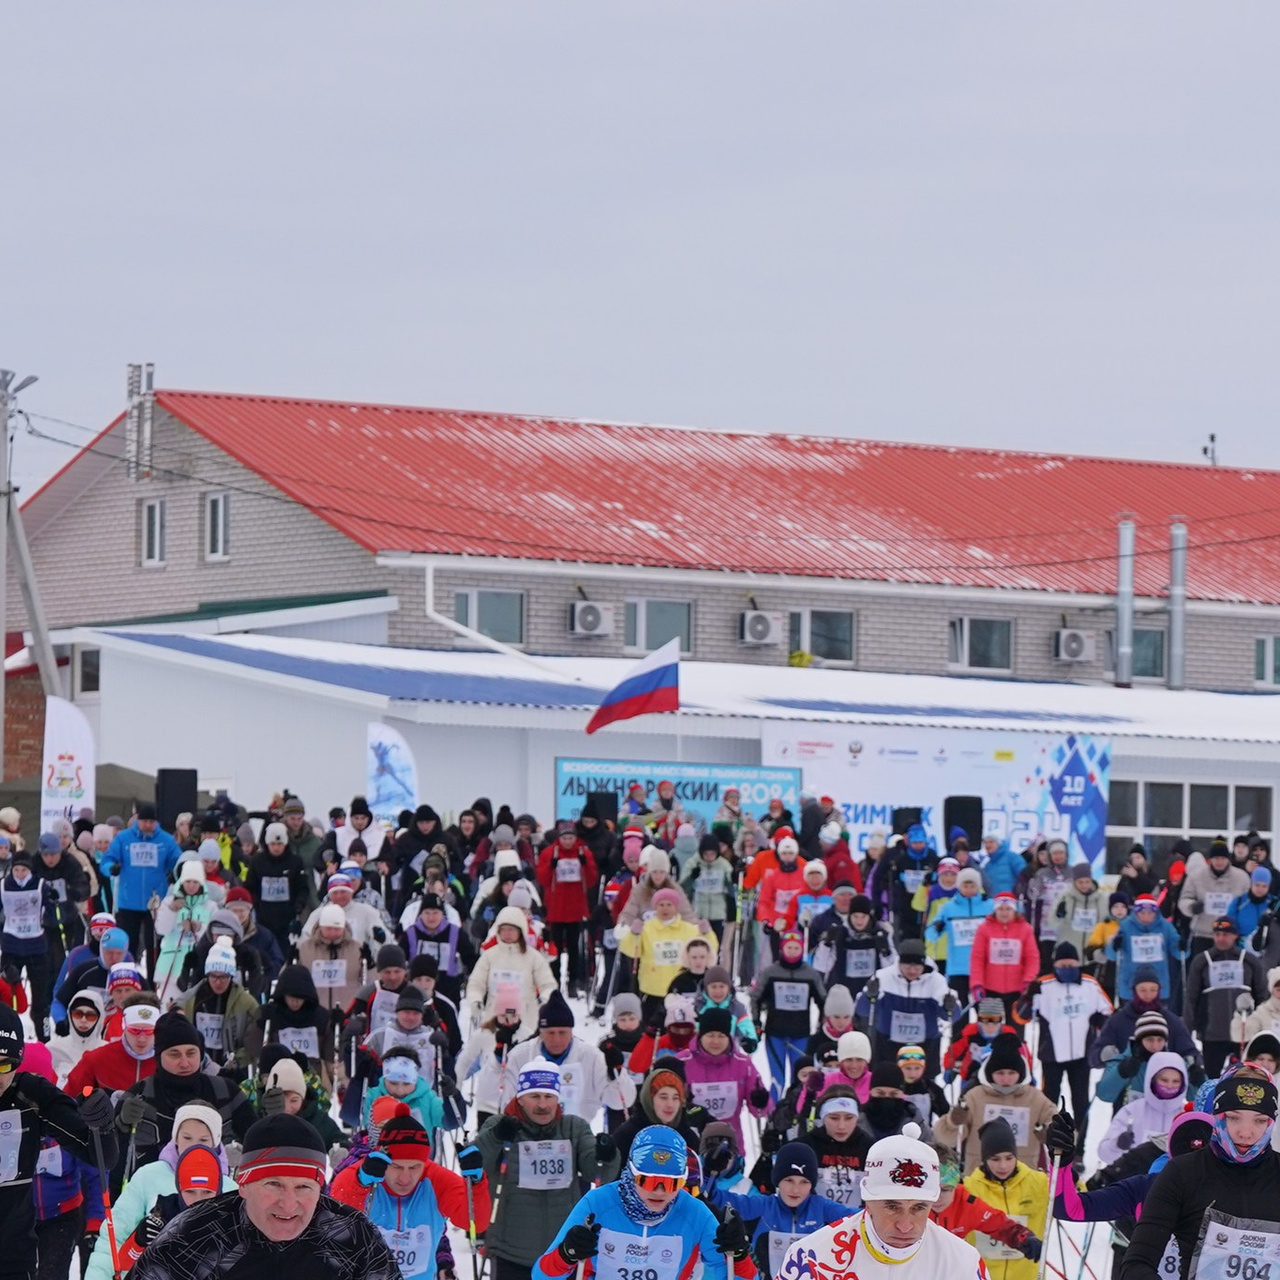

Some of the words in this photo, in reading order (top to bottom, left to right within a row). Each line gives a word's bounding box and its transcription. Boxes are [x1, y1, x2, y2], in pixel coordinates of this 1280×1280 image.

[1062, 775, 1085, 793] 10
[647, 780, 718, 802] РССИИ
[842, 803, 932, 826] ЗИМХ
[322, 969, 338, 979] 707
[705, 1097, 727, 1110] 387
[382, 1129, 430, 1142] UFC
[531, 1159, 565, 1175] 1838
[826, 1188, 853, 1204] 927
[1239, 1240, 1265, 1249] РОССИИ
[1240, 1234, 1266, 1243] ЛЫЖНЯ
[1238, 1246, 1265, 1257] 2024
